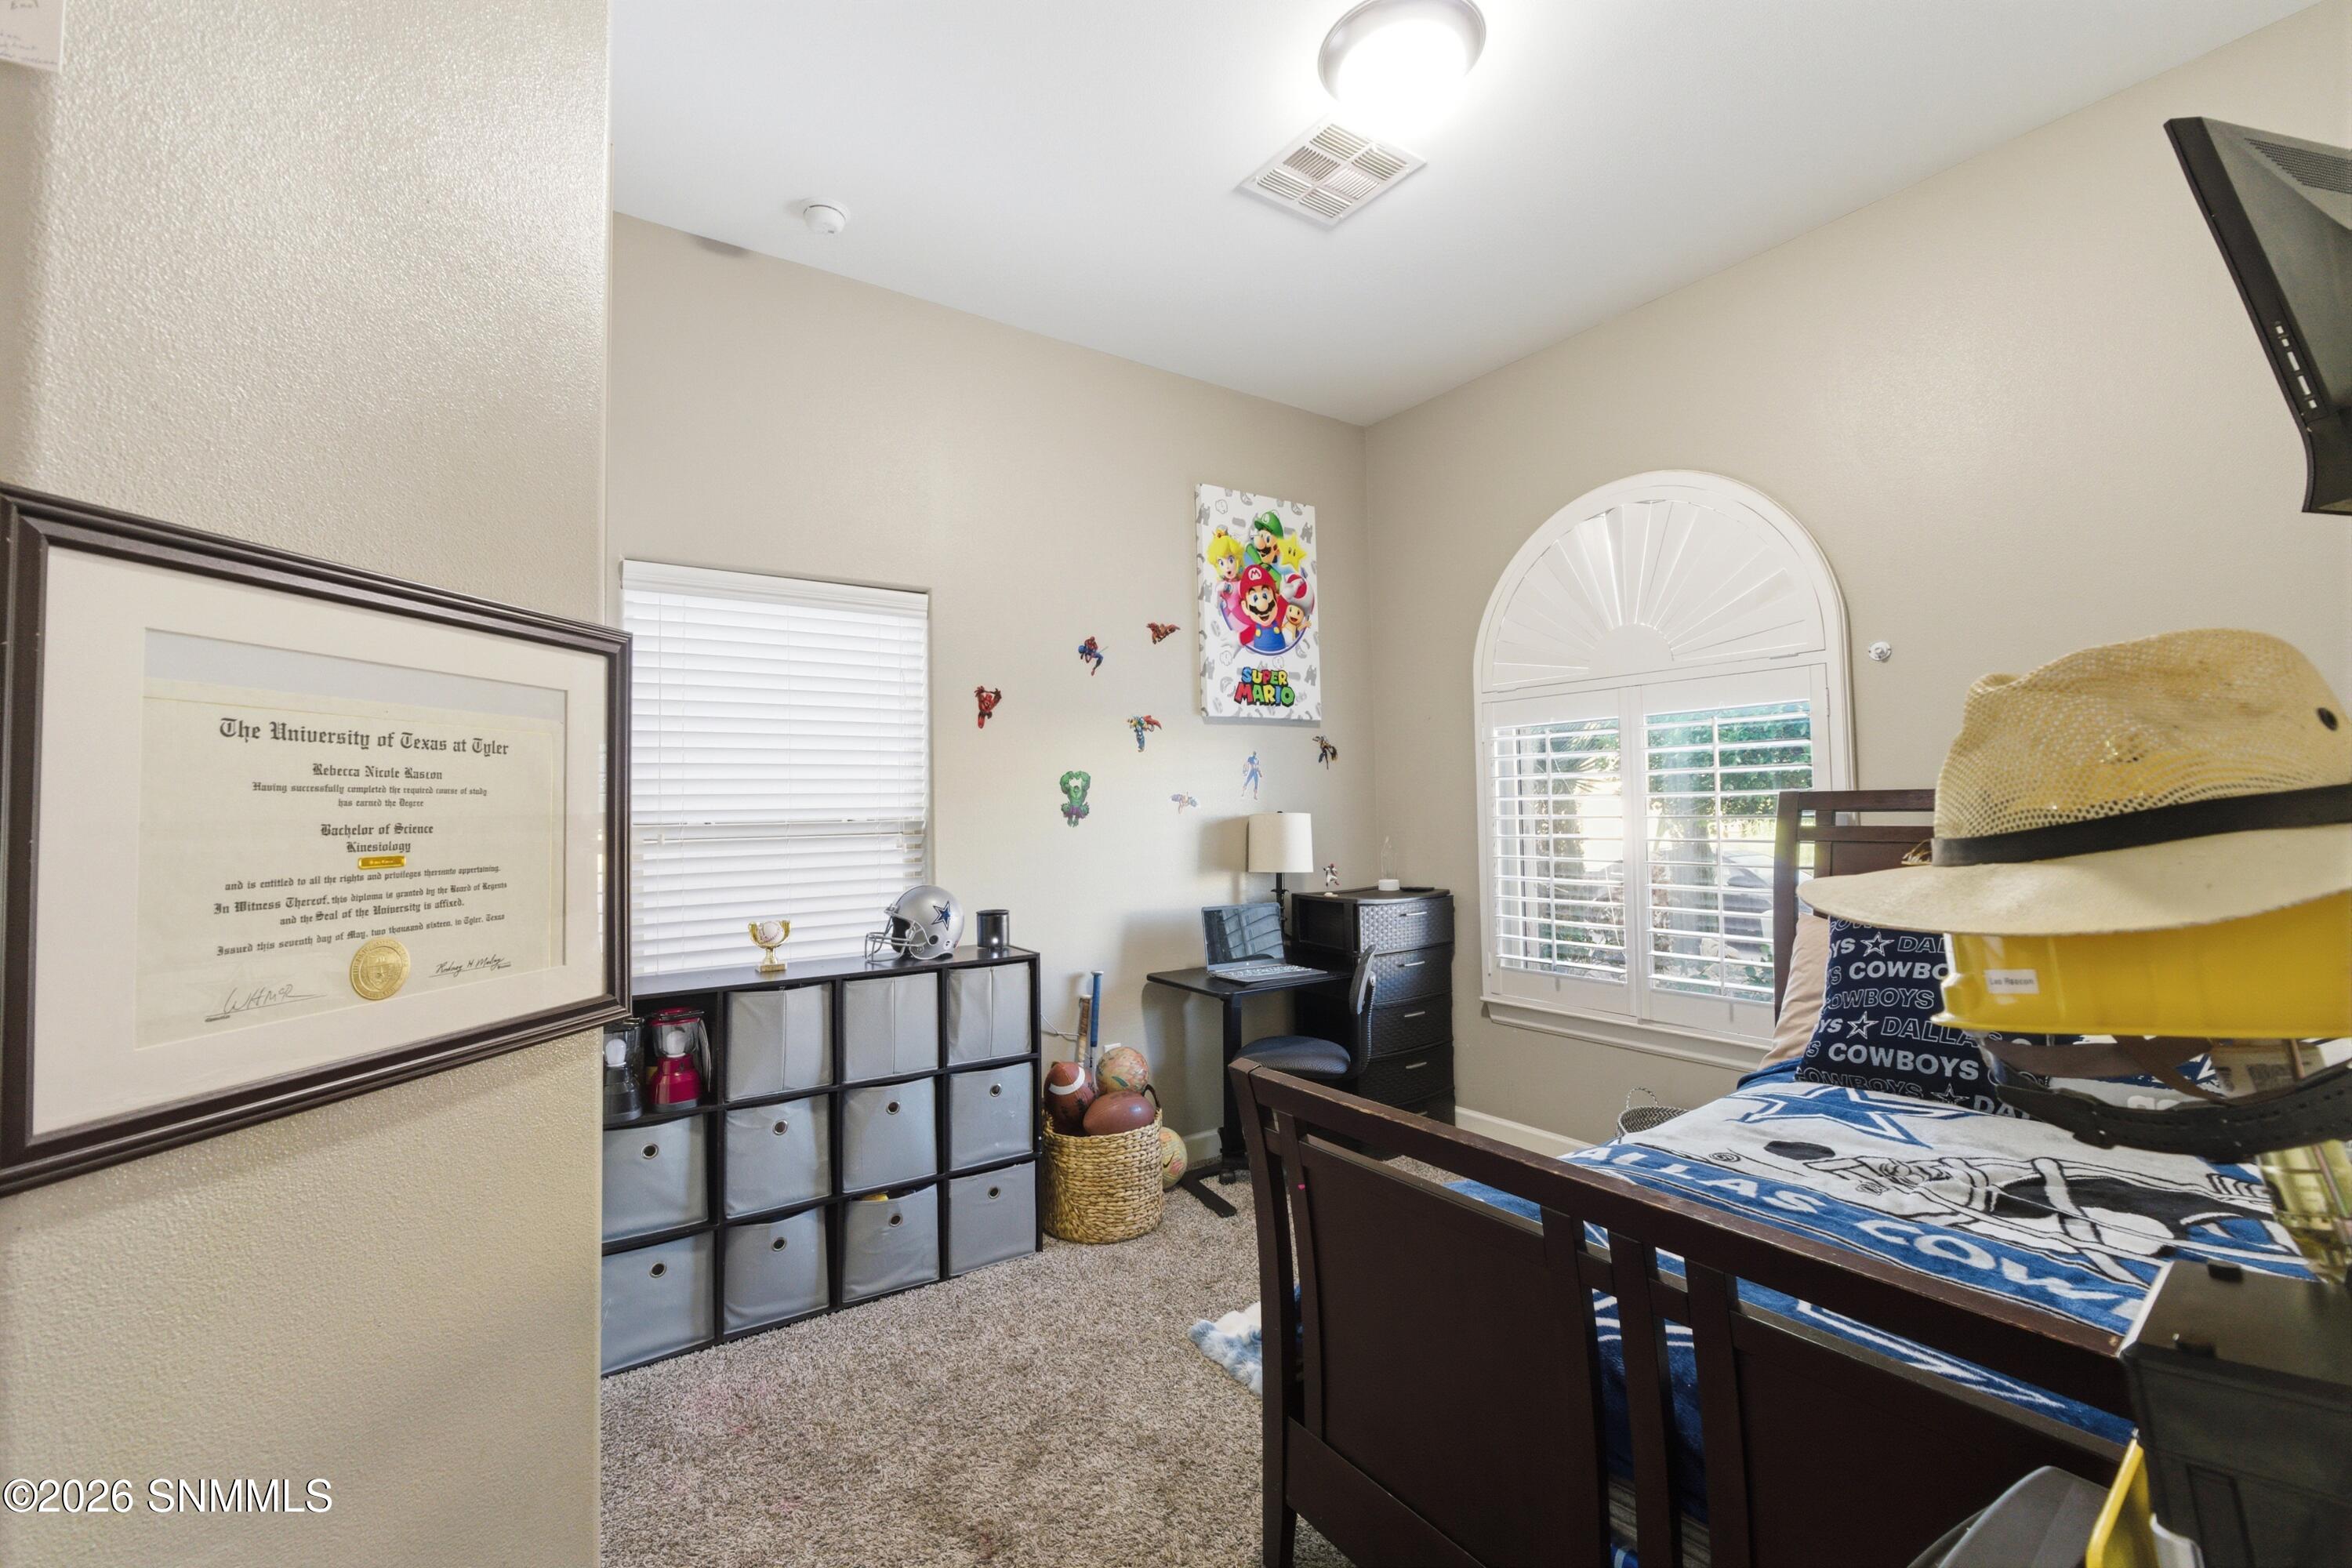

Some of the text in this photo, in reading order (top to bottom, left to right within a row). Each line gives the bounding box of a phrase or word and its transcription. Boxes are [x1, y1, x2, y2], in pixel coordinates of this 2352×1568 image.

[1241, 666, 1288, 686] SUPER
[1234, 681, 1295, 707] MARIO
[220, 717, 509, 757] The University of Texas at Tyler
[313, 763, 360, 777] Rebecca
[365, 765, 400, 779] Nicole
[252, 782, 287, 793] Having
[291, 784, 344, 794] successfully
[347, 786, 387, 795] completed
[390, 786, 401, 795] the
[404, 786, 433, 796] required
[338, 798, 352, 808] has
[385, 799, 396, 808] the
[399, 798, 424, 808] Degree
[321, 822, 434, 837] Bachelor of Science
[347, 841, 411, 853] Kinesiology
[225, 881, 243, 891] and
[260, 878, 294, 888] entitled
[310, 876, 321, 884] all
[324, 876, 336, 885] the
[339, 873, 364, 884] rights
[384, 870, 421, 880] privileges
[213, 903, 230, 914] In
[234, 901, 281, 912] Witness
[332, 895, 347, 905] this
[350, 893, 383, 902] diploma
[396, 889, 423, 900] granted
[426, 887, 435, 896] by
[437, 887, 448, 895] the
[450, 884, 471, 893] Board
[482, 882, 507, 891] Regents
[280, 916, 296, 925] and
[300, 915, 313, 924] the
[315, 910, 338, 921] Seal
[342, 909, 353, 919] of
[355, 908, 368, 918] the
[373, 902, 420, 915] University
[424, 902, 431, 910] is
[217, 942, 253, 956] Issued
[257, 942, 275, 952] this
[278, 935, 313, 948] seventh
[317, 935, 332, 944] day
[336, 932, 345, 941] of
[389, 922, 423, 934] thousand
[456, 917, 462, 926] in
[486, 913, 505, 922] Texas
[1849, 960, 1949, 981] COWBO
[1828, 1042, 1980, 1081] COWBOYS
[1573, 1146, 1827, 1214] ALLAS
